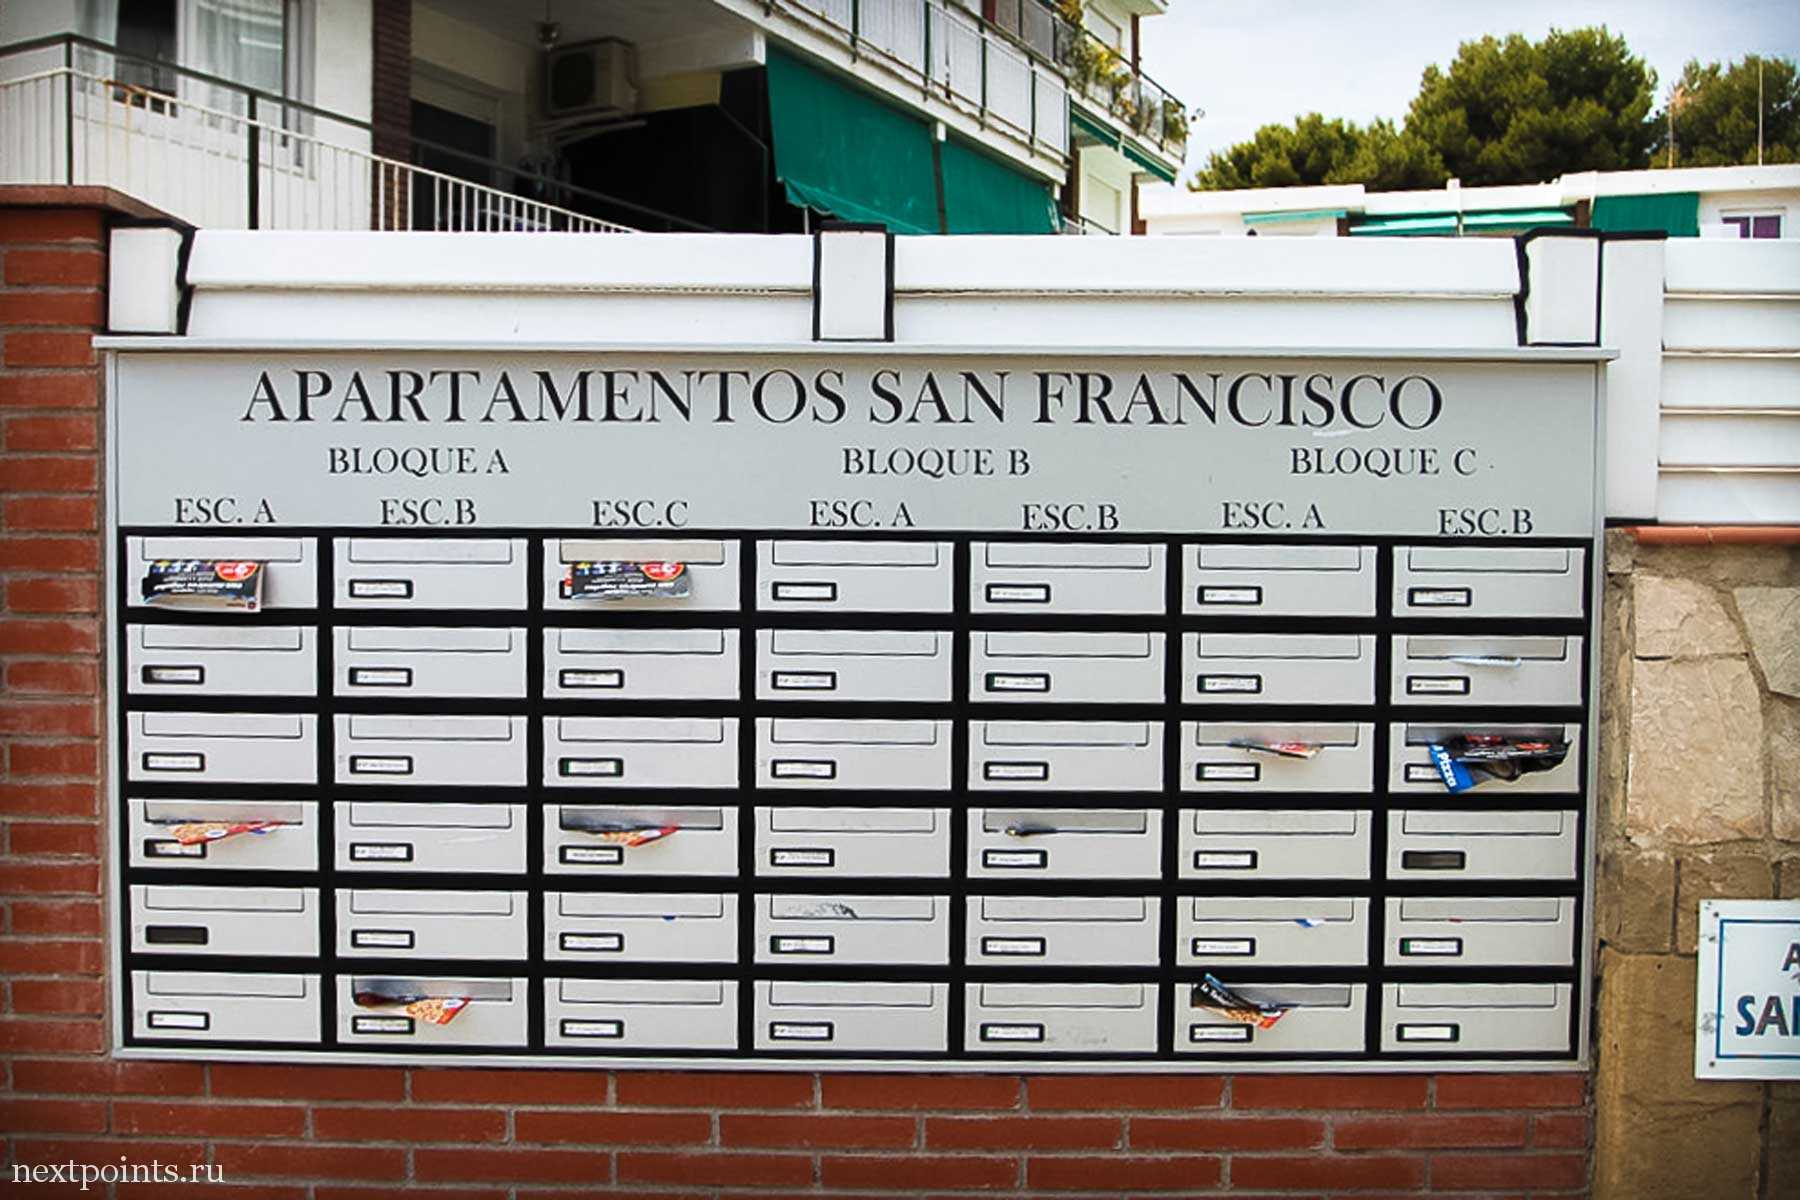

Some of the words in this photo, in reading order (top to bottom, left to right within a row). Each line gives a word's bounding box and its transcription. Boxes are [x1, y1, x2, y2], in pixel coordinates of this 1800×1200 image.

[240, 368, 846, 424] APARTAMENTOS
[868, 369, 1011, 424] SAN
[1033, 371, 1442, 430] FRANCISCO
[328, 447, 479, 478] BLOQUE
[486, 448, 509, 475] A
[842, 448, 994, 478] BLOQUE
[1008, 449, 1031, 476] B
[1290, 447, 1441, 478] BLOQUE
[1453, 448, 1476, 476] C
[175, 498, 243, 525] ESC.
[252, 498, 277, 525] A
[810, 500, 881, 528] ESC.
[891, 502, 915, 528] A
[1222, 502, 1293, 529] ESC.
[1301, 503, 1326, 530] A
